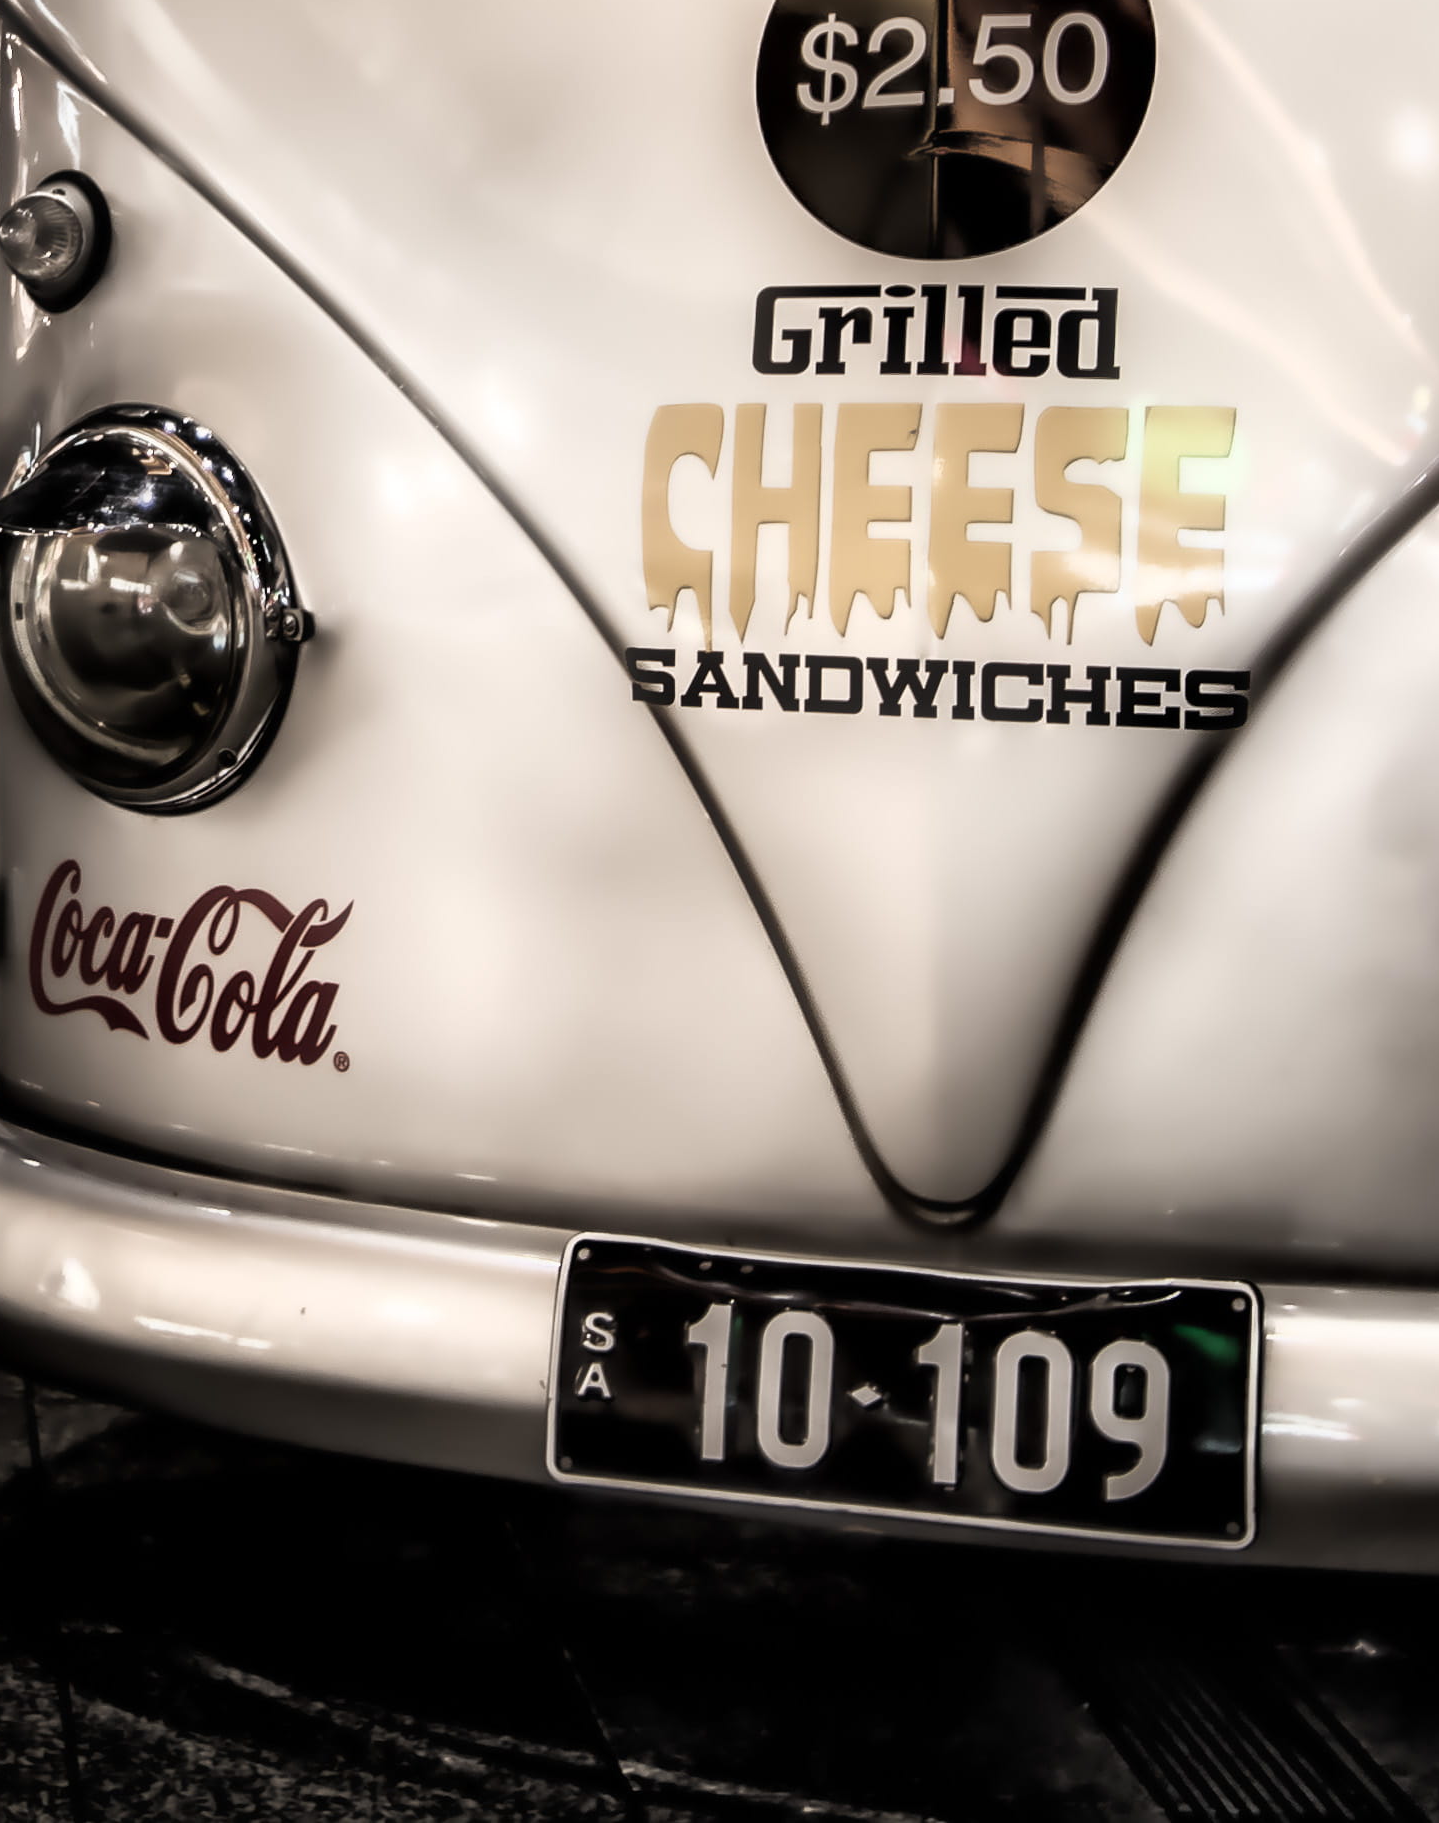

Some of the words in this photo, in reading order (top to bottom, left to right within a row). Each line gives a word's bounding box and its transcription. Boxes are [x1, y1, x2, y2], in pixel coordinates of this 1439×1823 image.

[796, 11, 1111, 126] $2.50
[752, 283, 1121, 380] Grilled
[640, 401, 1238, 652] CHEESE
[625, 647, 1252, 731] SANDWICHES
